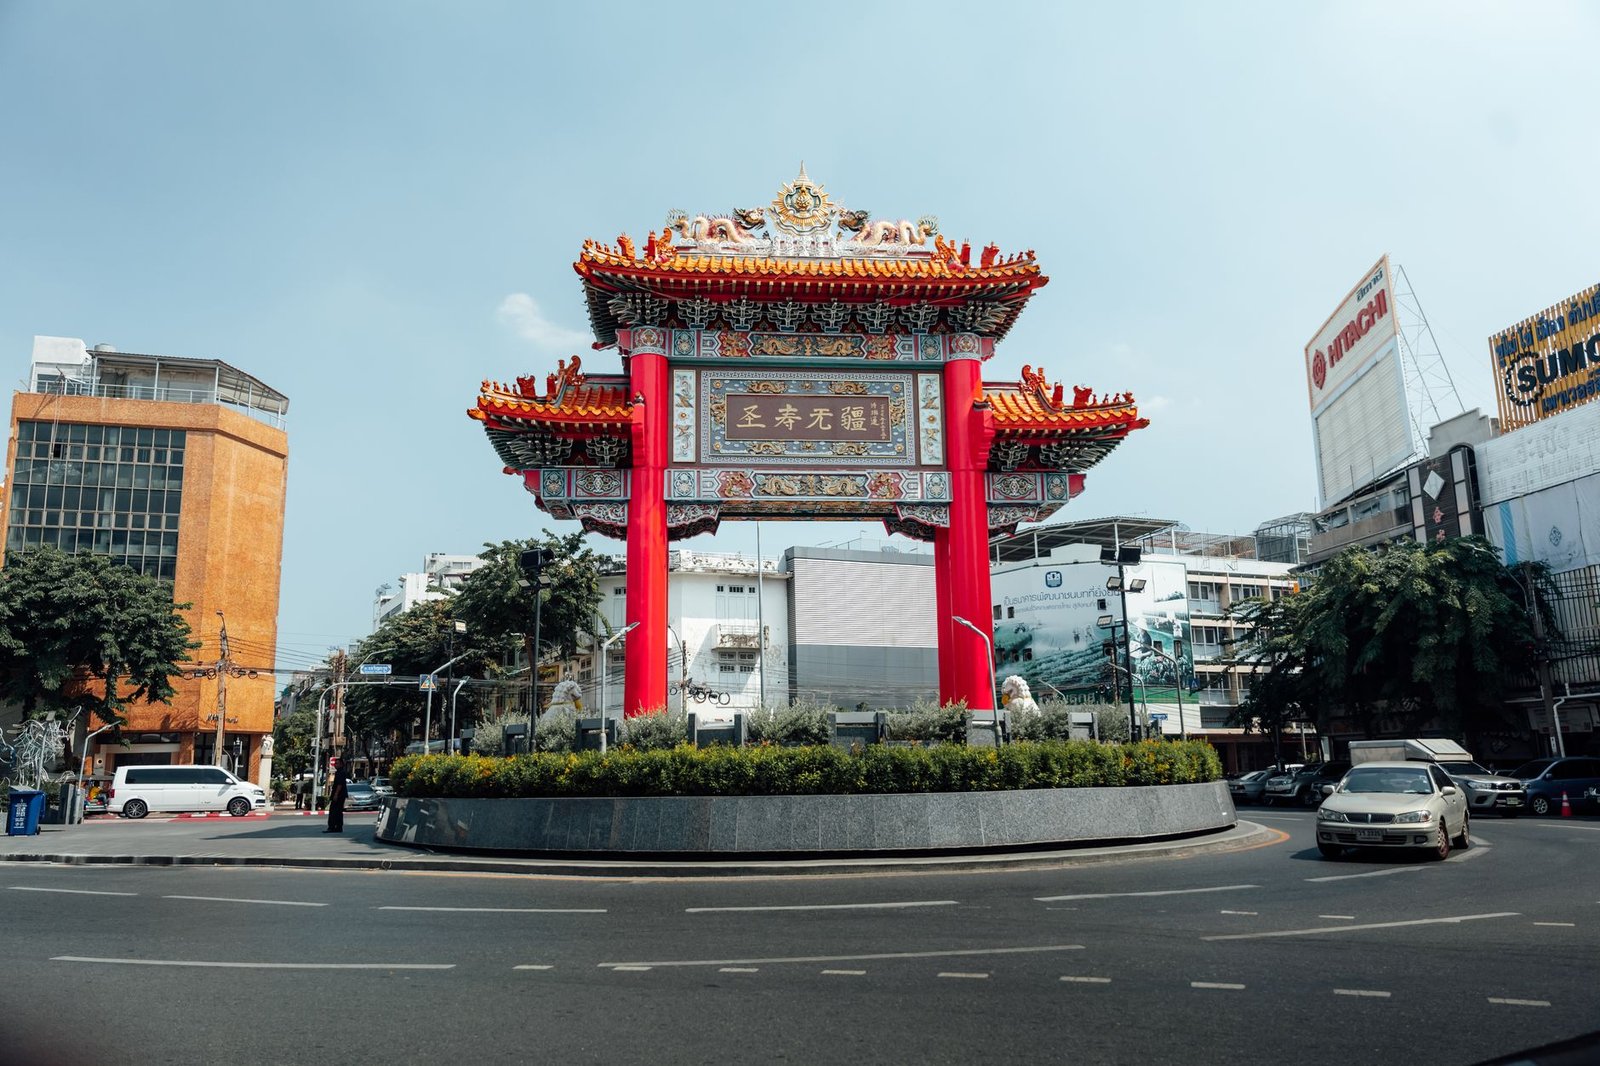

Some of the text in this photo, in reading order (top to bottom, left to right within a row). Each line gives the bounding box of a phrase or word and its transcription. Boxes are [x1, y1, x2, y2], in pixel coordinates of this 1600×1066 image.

[1327, 288, 1388, 368] HITACHI
[736, 403, 867, 432] 圣寿无疆
